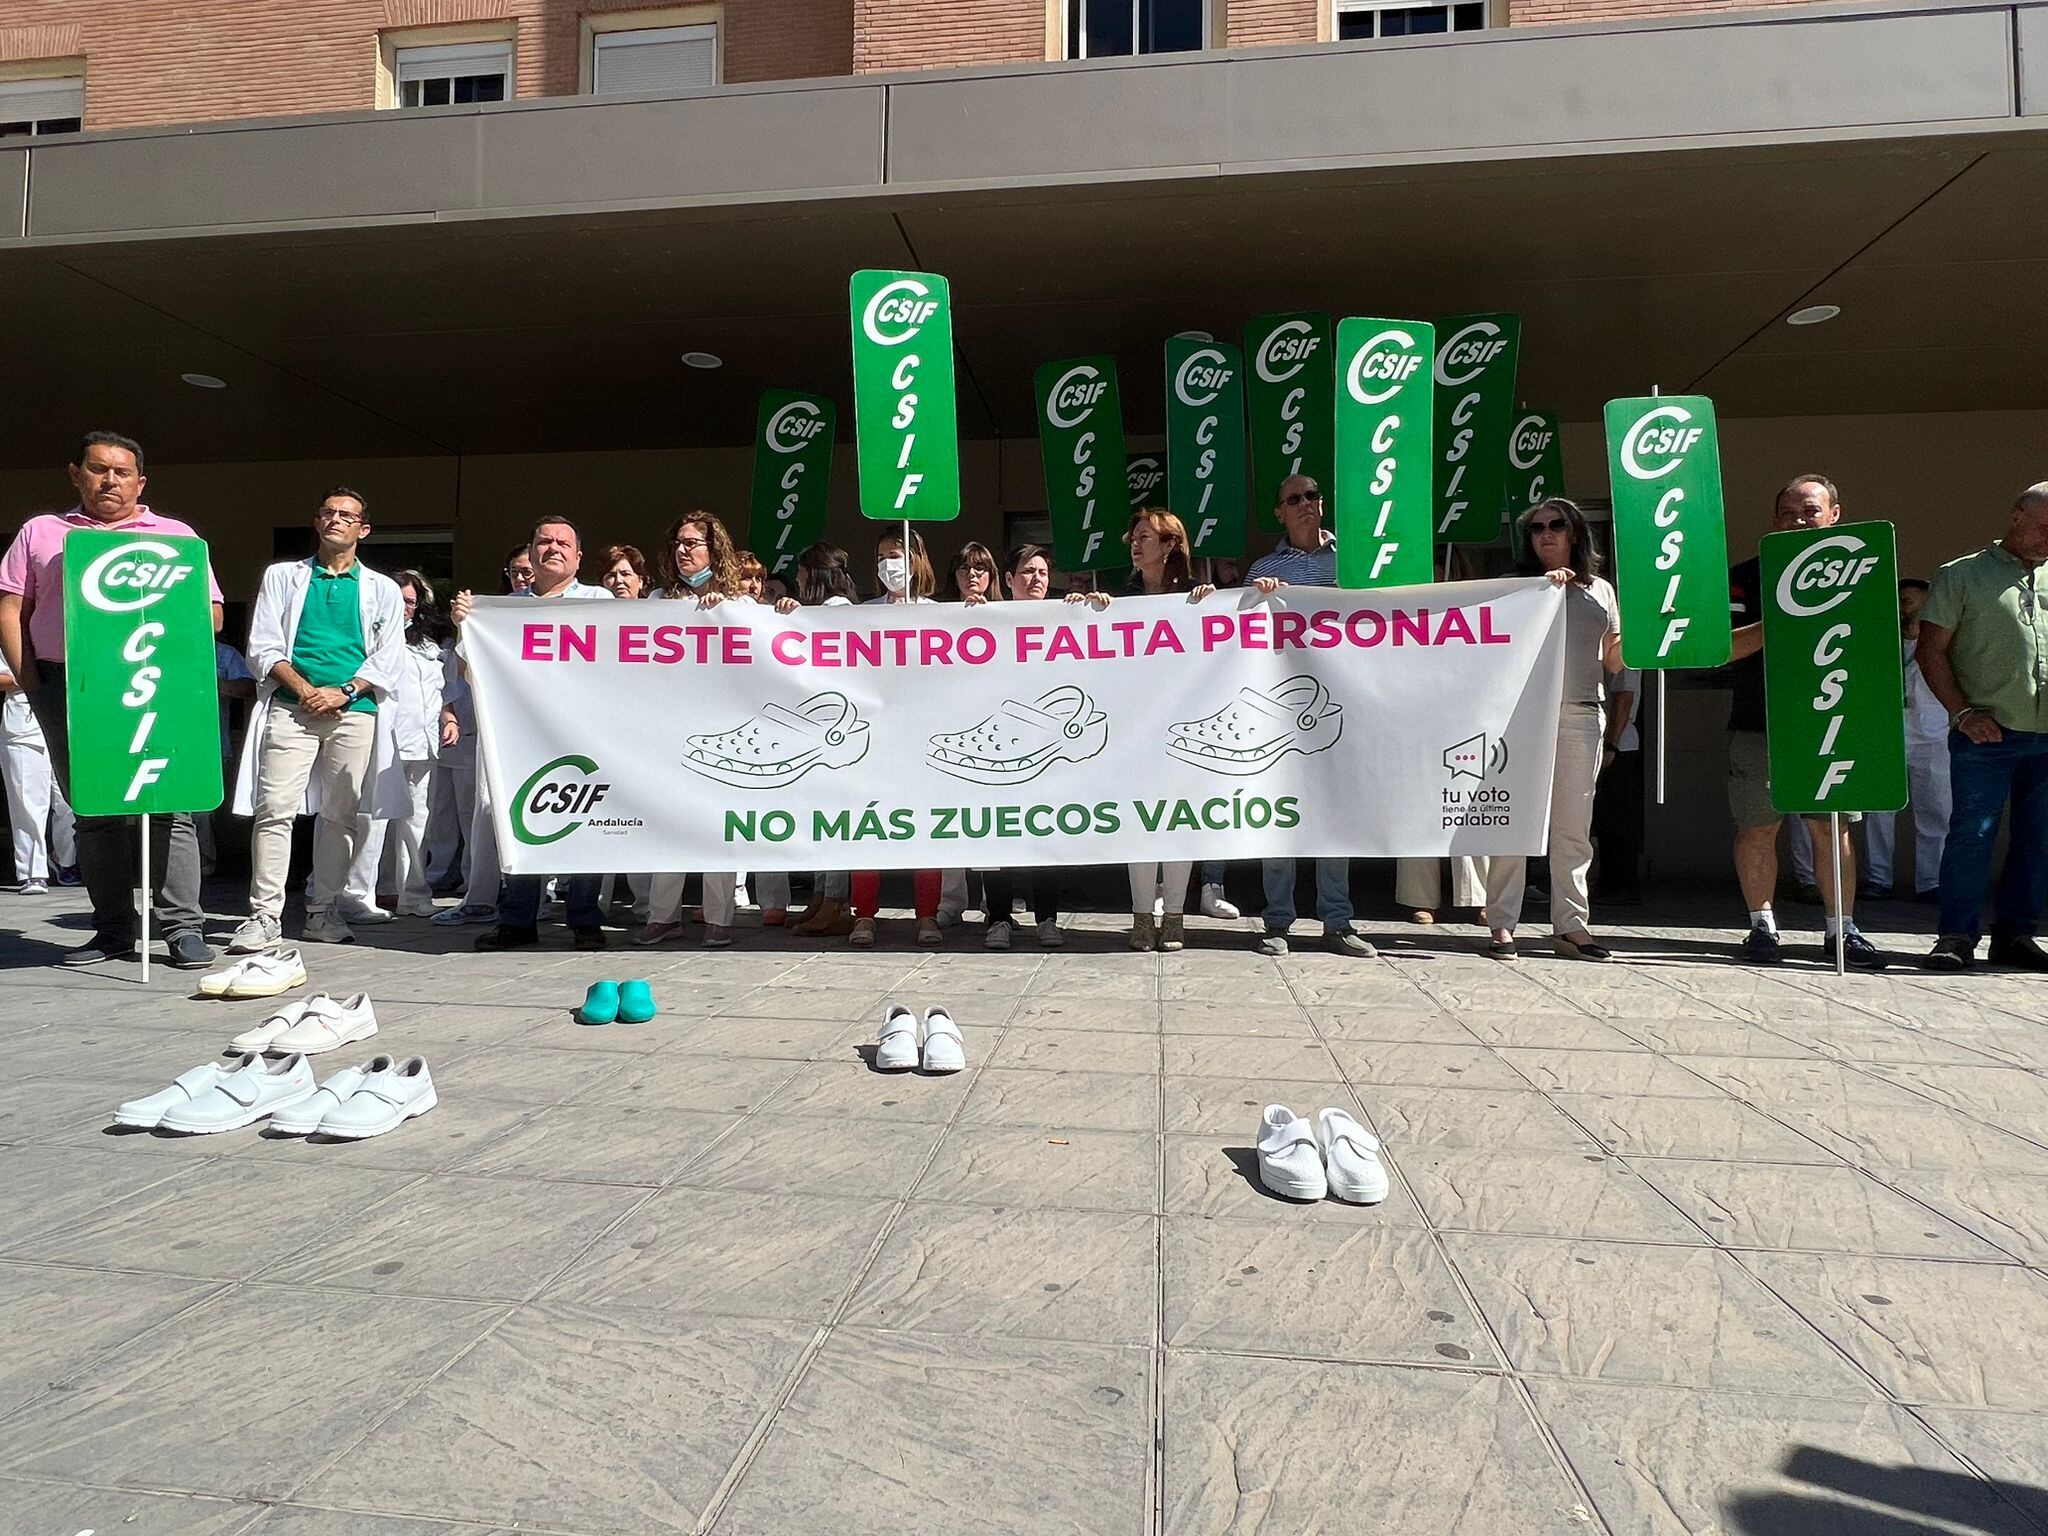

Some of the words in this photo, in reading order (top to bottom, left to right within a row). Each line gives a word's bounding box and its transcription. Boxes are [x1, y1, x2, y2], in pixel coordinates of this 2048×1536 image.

[892, 355, 923, 508] CSIF
[1195, 416, 1217, 547] CSIF
[1281, 388, 1305, 476] CSI
[1438, 393, 1480, 533] CSIF
[772, 463, 804, 573] CSIF
[1074, 432, 1104, 562] CSIF
[1370, 415, 1400, 578] CSIF
[1655, 488, 1690, 656] CSIF
[522, 624, 597, 662] EN
[618, 625, 752, 665] ESTE
[771, 627, 997, 667] CENTRO
[1016, 620, 1184, 663] FALTA
[1202, 607, 1510, 652] PERSONAL
[122, 622, 168, 802] CSIF
[1813, 624, 1854, 800] CSIF
[588, 818, 643, 827] Andalucía
[725, 811, 796, 843] NO
[812, 801, 916, 842] MÁS
[931, 801, 1120, 840] ZUECOS
[1134, 789, 1300, 834] VACÍOS
[1442, 788, 1461, 803] tu
[1468, 787, 1510, 802] voto
[1442, 805, 1465, 813] tiene
[1480, 804, 1510, 813] última
[1443, 813, 1510, 829] palabra
